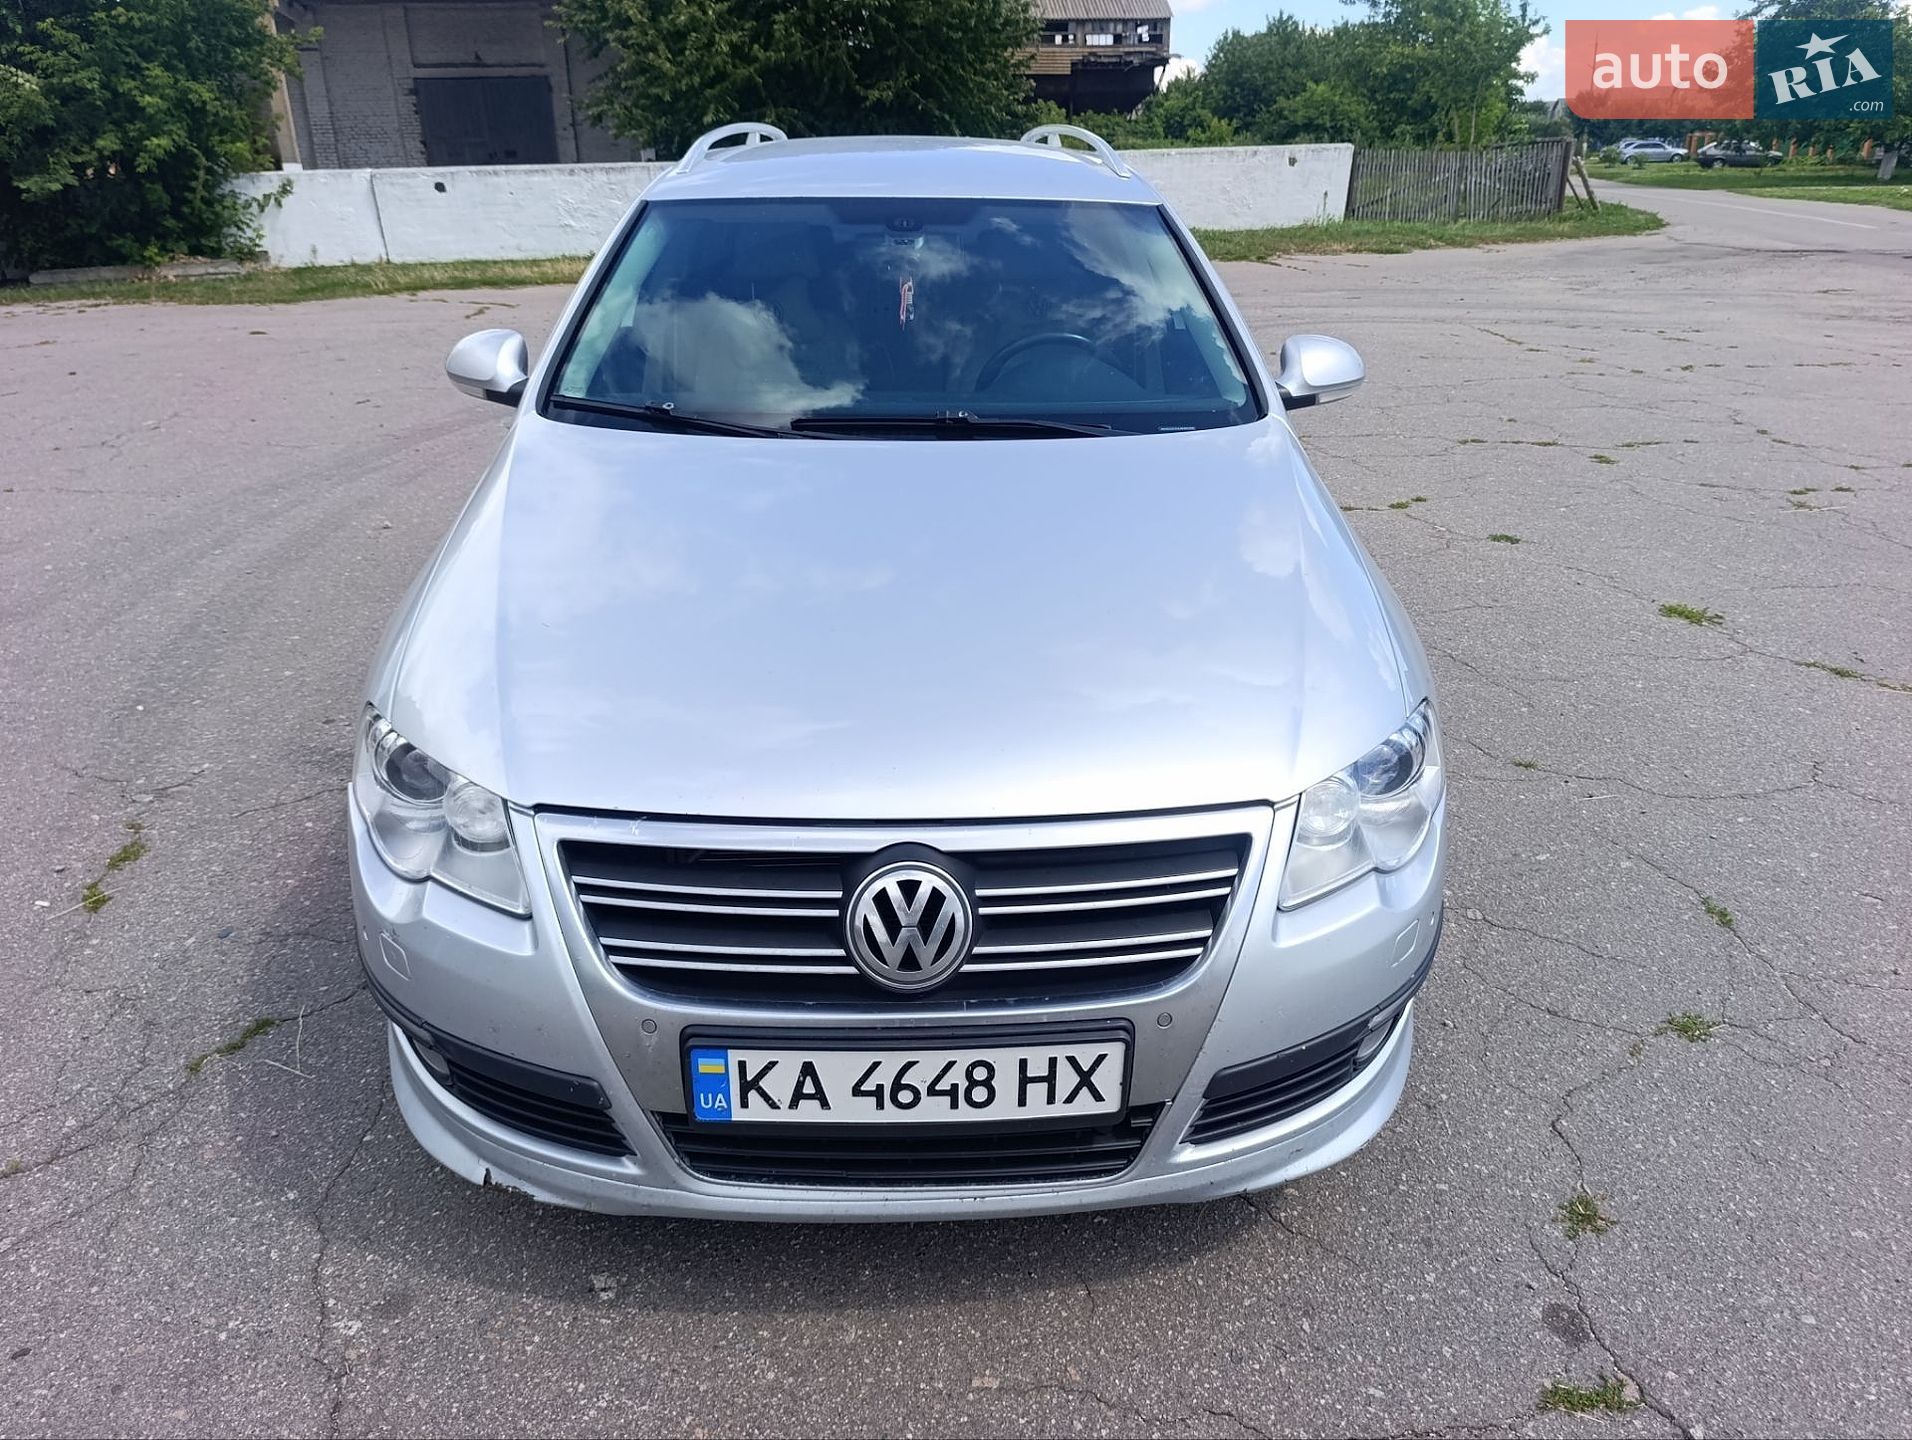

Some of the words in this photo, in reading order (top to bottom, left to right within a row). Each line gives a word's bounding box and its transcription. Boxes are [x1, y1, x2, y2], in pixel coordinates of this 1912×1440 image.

[855, 869, 965, 981] VW
[700, 1093, 728, 1110] UA
[737, 1060, 832, 1110] KA
[851, 1060, 997, 1110] 4648
[1017, 1053, 1108, 1107] HX
